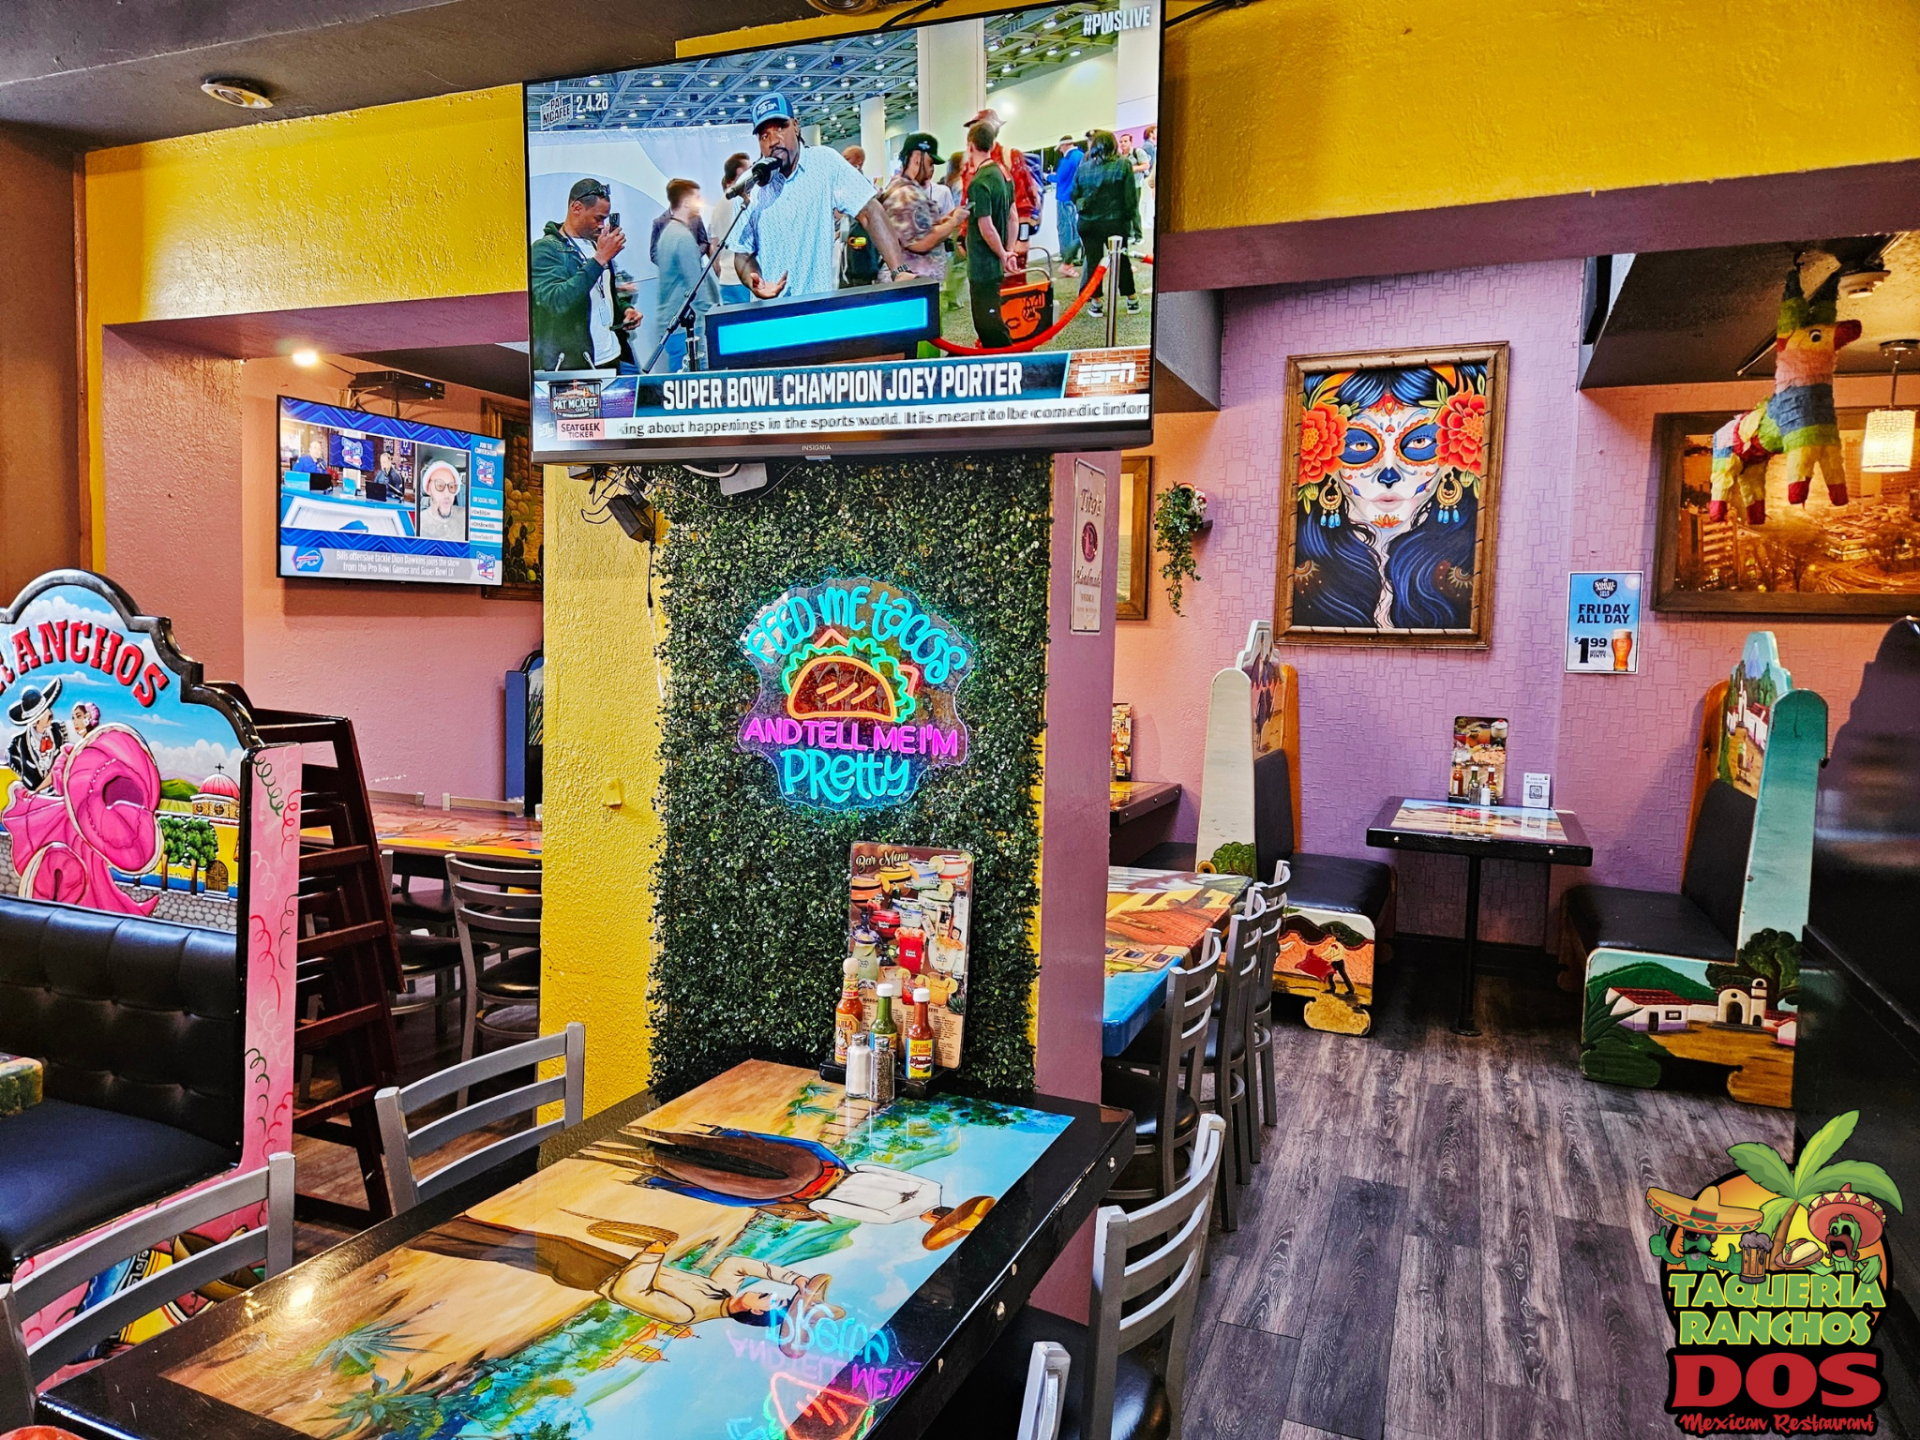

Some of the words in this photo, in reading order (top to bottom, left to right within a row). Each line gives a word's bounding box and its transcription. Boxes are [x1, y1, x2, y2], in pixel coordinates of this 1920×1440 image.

[1082, 6, 1151, 36] #PMSLIVE
[576, 92, 609, 113] 2.4.26
[1077, 362, 1136, 385] ESPN
[663, 378, 723, 411] SUPER
[727, 375, 779, 408] BOWL
[782, 370, 883, 406] CHAMPION
[886, 366, 937, 401] JOEY
[941, 361, 1023, 398] PORTER
[553, 400, 567, 411] PAT
[568, 397, 598, 409] MCAFEE
[561, 421, 601, 432] SEATGEEK
[647, 421, 685, 434] about
[688, 418, 765, 434] happenings
[768, 418, 781, 429] in
[785, 416, 807, 428] the
[810, 415, 855, 430] sports
[936, 409, 985, 422] meant
[1030, 403, 1101, 418] comedic
[568, 431, 594, 439] TICKER
[336, 550, 349, 560] Bills
[358, 562, 367, 572] the
[367, 563, 378, 573] Pro
[1577, 614, 1600, 624] ALL
[1604, 614, 1630, 624] DAY
[1578, 604, 1631, 614] FRIDAY
[747, 596, 816, 664] FEED
[744, 717, 803, 744] AND
[801, 720, 868, 751] TELL
[873, 725, 916, 753] ME
[918, 723, 958, 757] I'M
[855, 855, 877, 873] Bar
[879, 850, 910, 869] Menu
